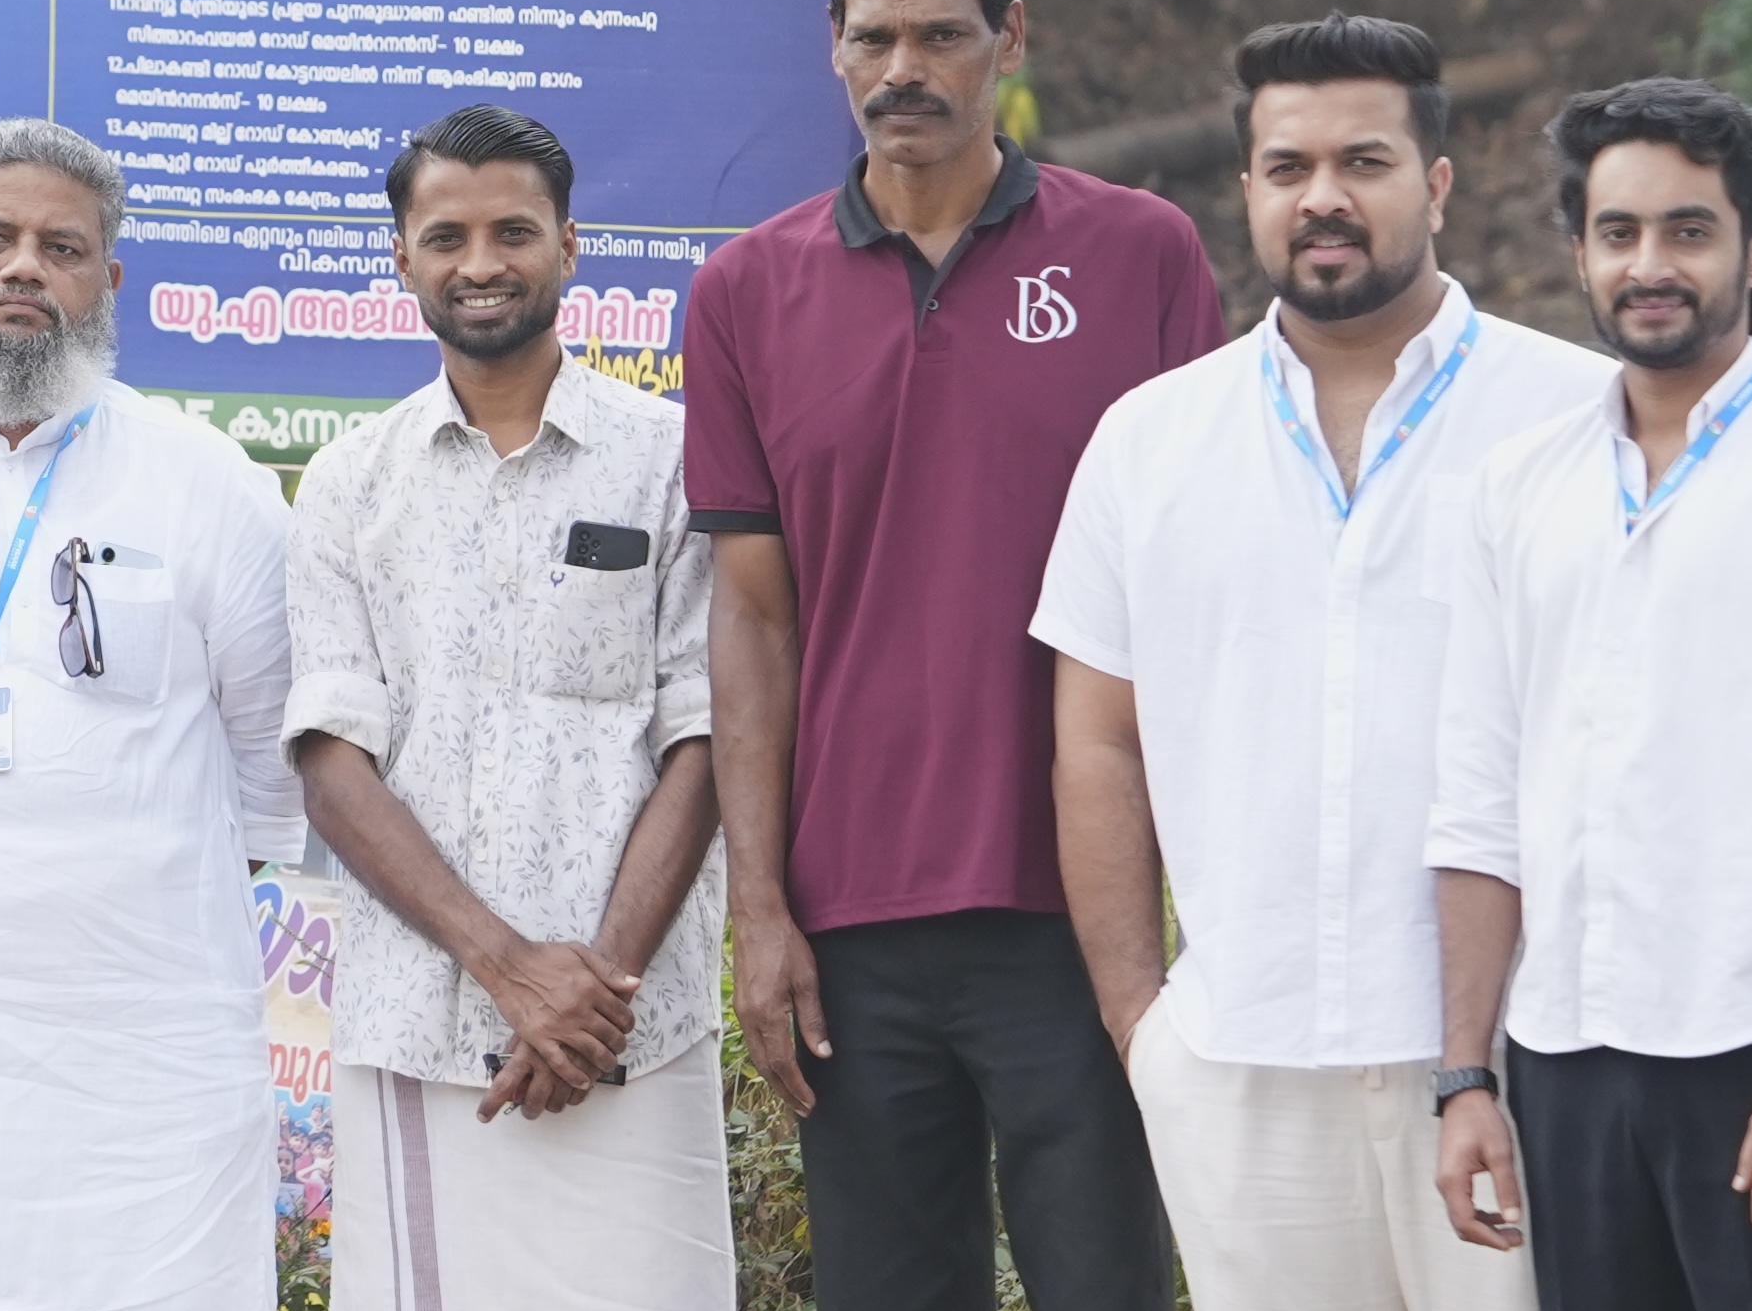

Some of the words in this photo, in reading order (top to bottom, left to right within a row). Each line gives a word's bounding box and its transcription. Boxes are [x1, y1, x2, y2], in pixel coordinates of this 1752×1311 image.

[116, 216, 230, 244] രിത്രത്തിലെ
[233, 225, 303, 251] ഏറ്റവും
[307, 225, 363, 249] വലിയ
[648, 236, 705, 265] നയിച്ച
